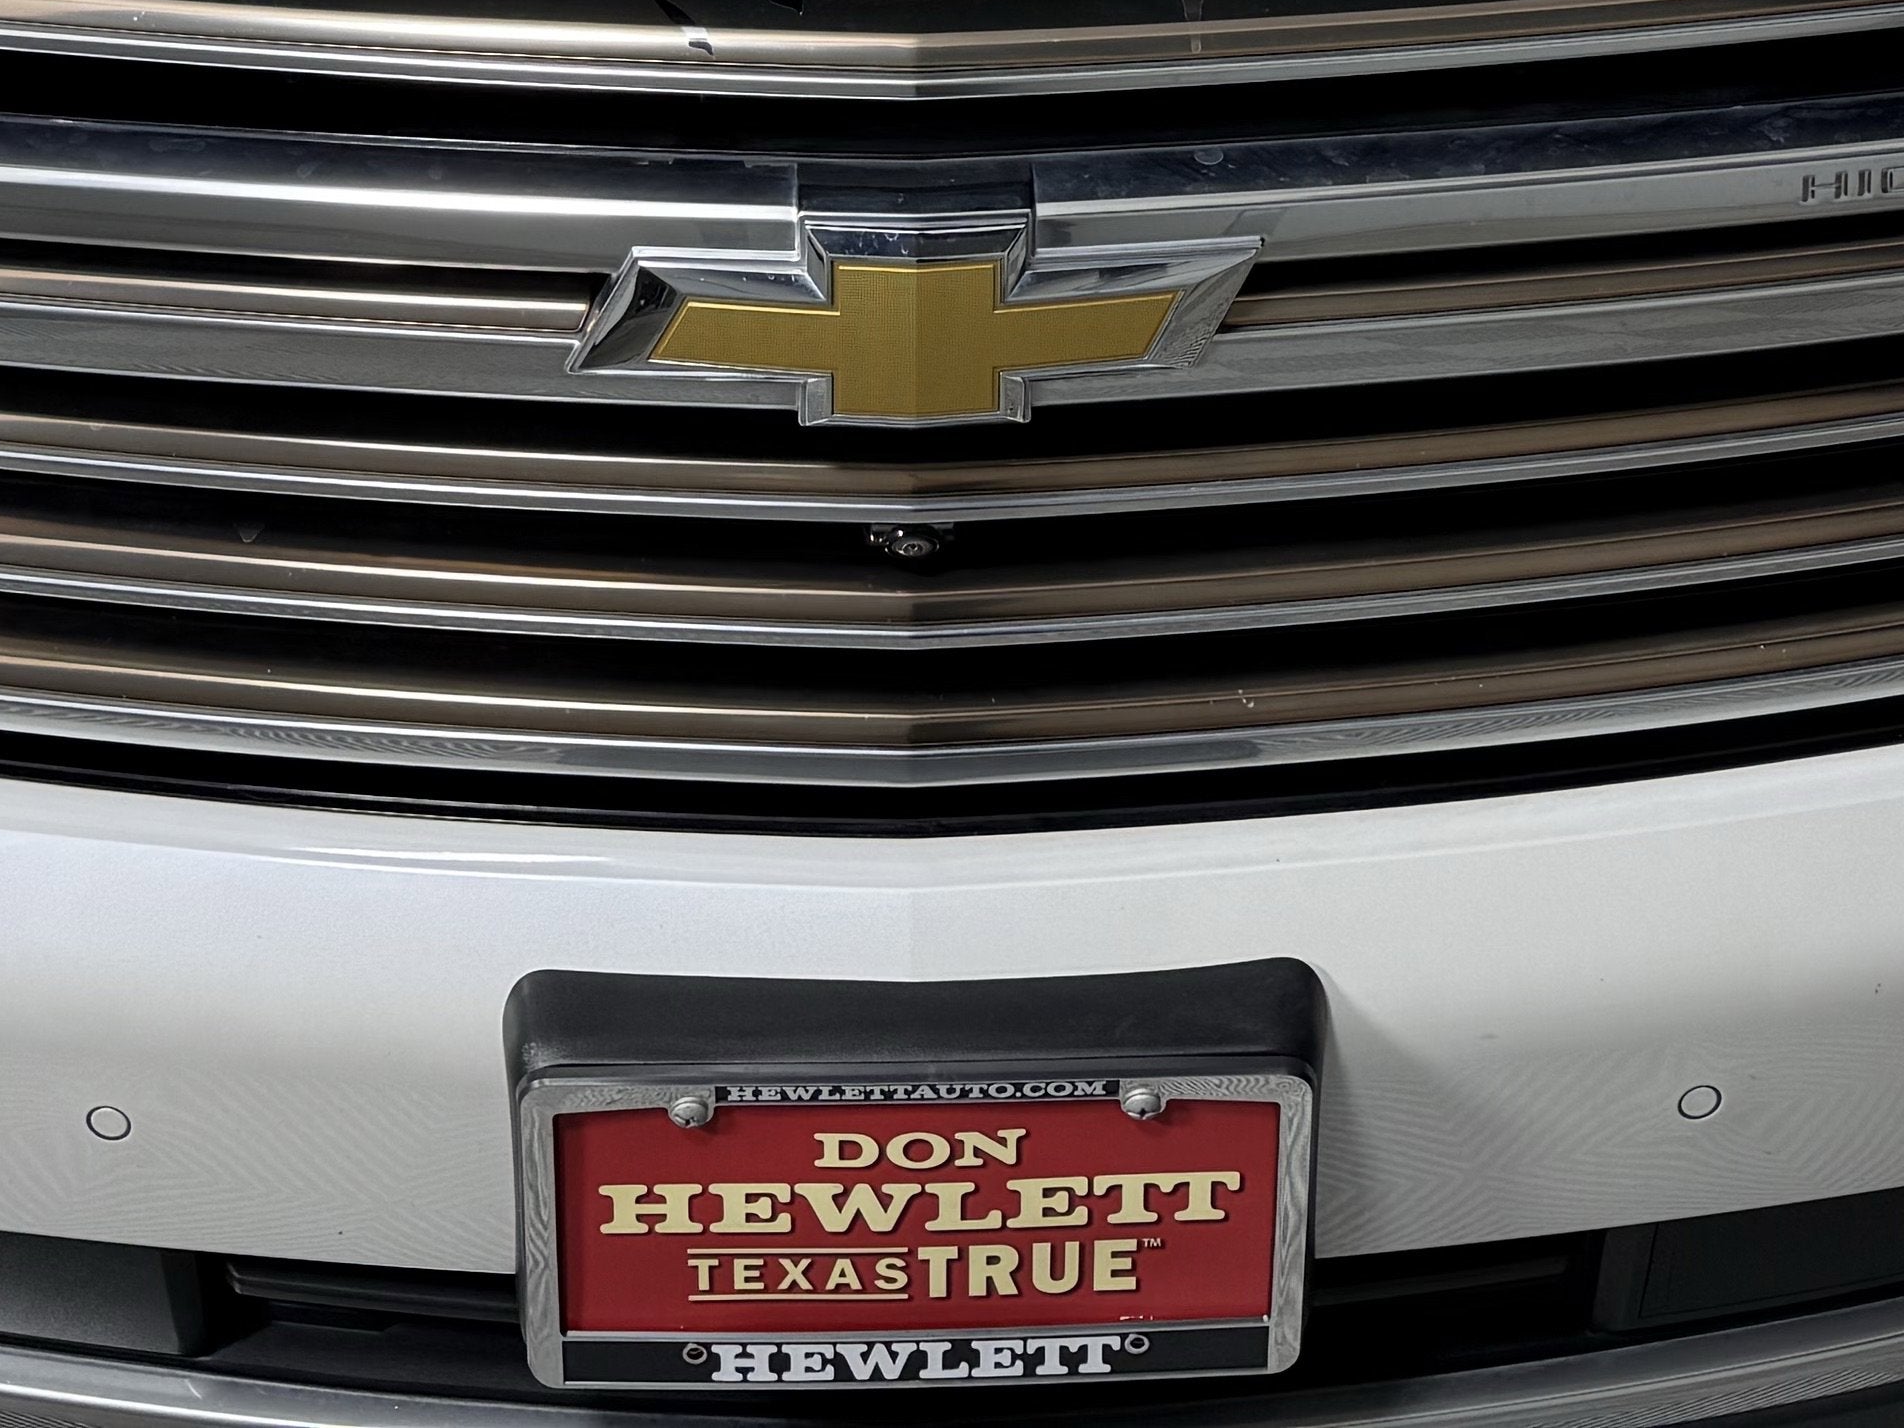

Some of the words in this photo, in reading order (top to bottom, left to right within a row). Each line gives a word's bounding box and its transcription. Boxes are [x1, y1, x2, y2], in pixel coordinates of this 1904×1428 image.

[726, 1080, 1107, 1102] HEWLETTAUTO.COM
[813, 1128, 1027, 1169] DON
[598, 1171, 1241, 1235] HEWLETT
[711, 1336, 1120, 1382] HEWLETT
